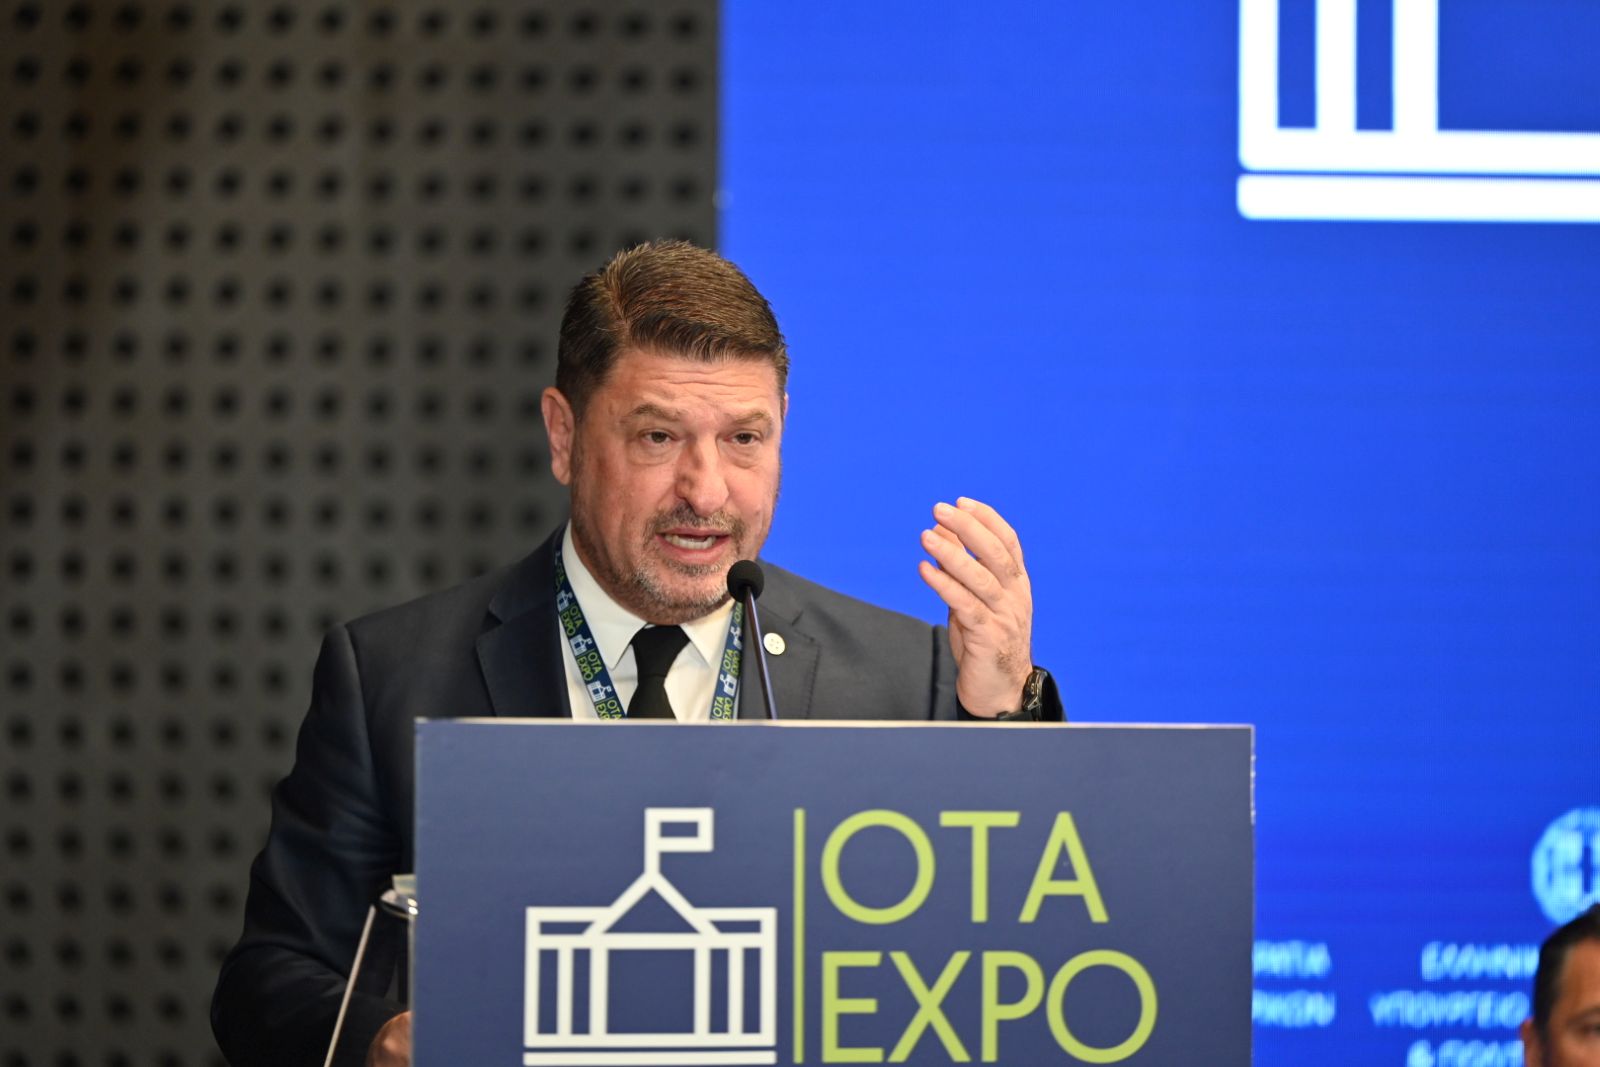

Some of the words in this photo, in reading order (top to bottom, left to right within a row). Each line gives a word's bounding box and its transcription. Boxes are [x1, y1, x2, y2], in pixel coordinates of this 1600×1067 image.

[561, 611, 576, 636] EXPO
[570, 605, 584, 629] OTA
[577, 656, 593, 681] EXPO
[588, 652, 602, 675] OTA
[723, 649, 734, 670] OTA
[596, 703, 610, 719] EXP
[713, 696, 725, 718] OTA
[821, 809, 1109, 924] OTA
[822, 949, 1157, 1064] EXPO
